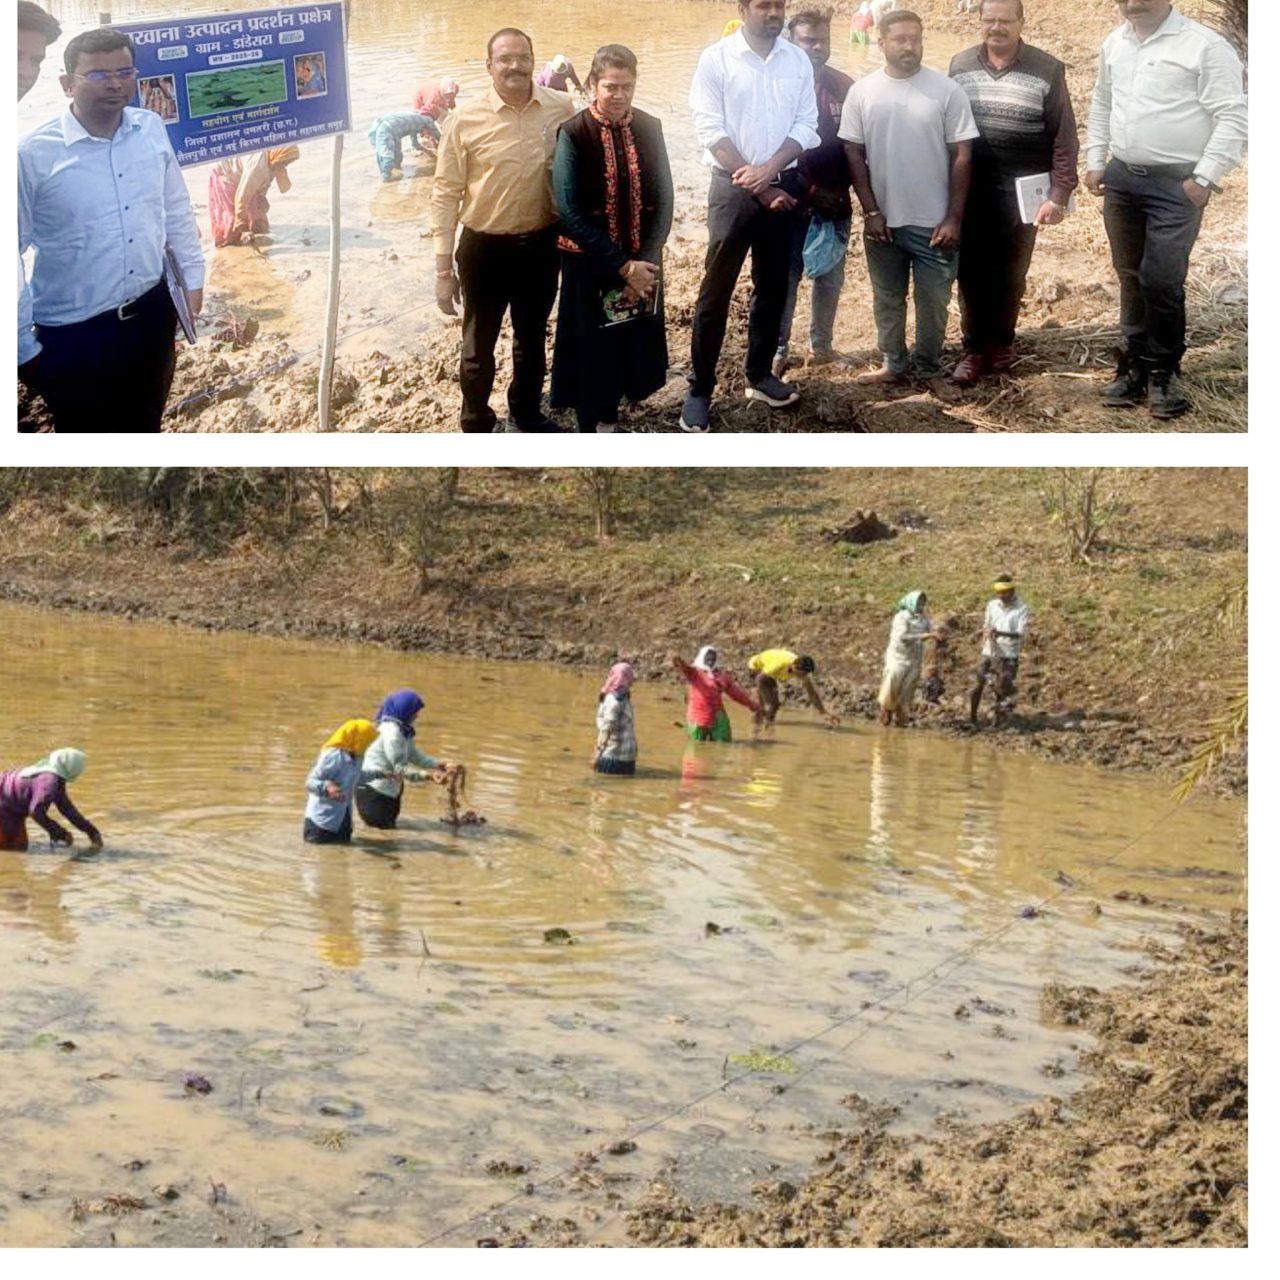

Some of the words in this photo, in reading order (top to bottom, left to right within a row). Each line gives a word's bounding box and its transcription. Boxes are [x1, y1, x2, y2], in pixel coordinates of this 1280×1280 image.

[184, 19, 243, 39] उत्पादन
[247, 10, 294, 32] प्रदर्शन
[298, 7, 332, 25] प्रक्षेत्र
[195, 41, 220, 55] ग्राम
[232, 34, 273, 50] डांडेसरा
